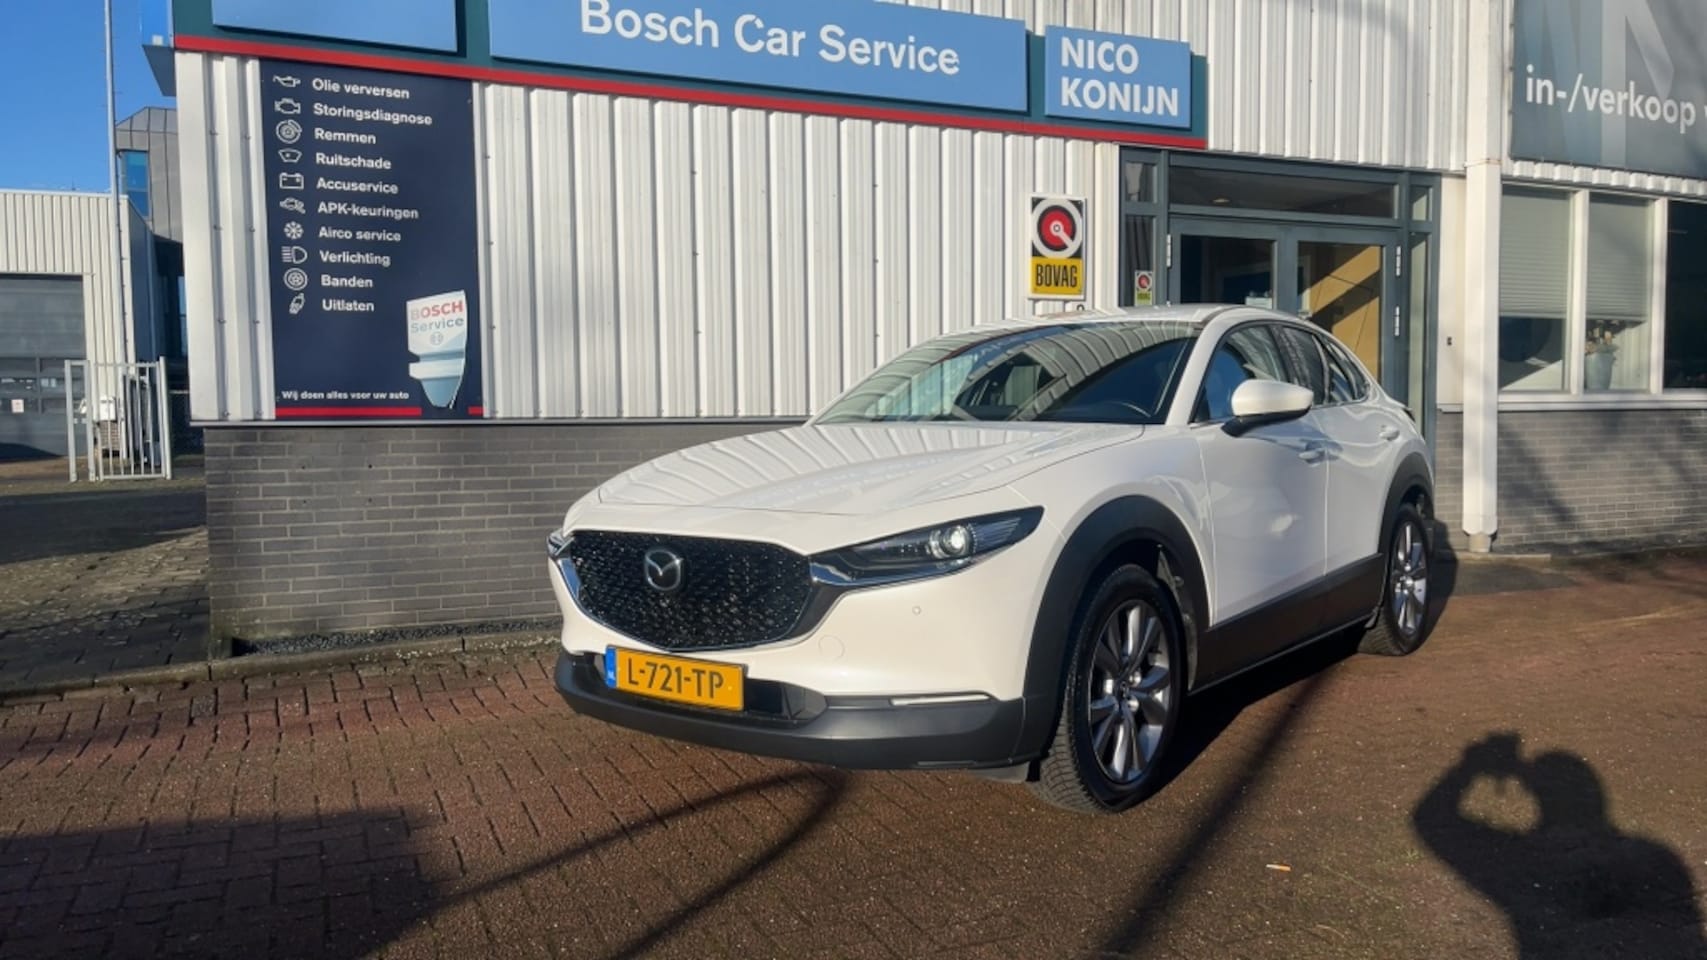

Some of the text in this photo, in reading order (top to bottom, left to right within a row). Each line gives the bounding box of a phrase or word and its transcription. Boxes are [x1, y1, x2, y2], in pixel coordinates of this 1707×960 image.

[580, 0, 960, 76] Bosch Car Service
[1061, 36, 1140, 75] NICO
[312, 78, 410, 100] Olie verversen
[1061, 76, 1179, 117] KONIJN
[1526, 63, 1696, 135] in-/verkoop
[313, 102, 433, 126] Storingsdiagnose
[314, 127, 377, 145] Remmen
[315, 152, 392, 170] Ruitschade
[316, 176, 399, 195] Accuservice
[317, 201, 419, 221] APK-keuringen
[318, 226, 402, 242] Airco service
[319, 249, 392, 268] Verlichting
[320, 273, 374, 288] Banden
[1035, 264, 1078, 288] BOVAG
[322, 298, 375, 312] Uitlaten
[410, 300, 464, 320] BOSCH
[410, 317, 465, 334] Service
[281, 390, 410, 401] Wij doen alles voor uw auto
[628, 657, 724, 699] L-721-TP
